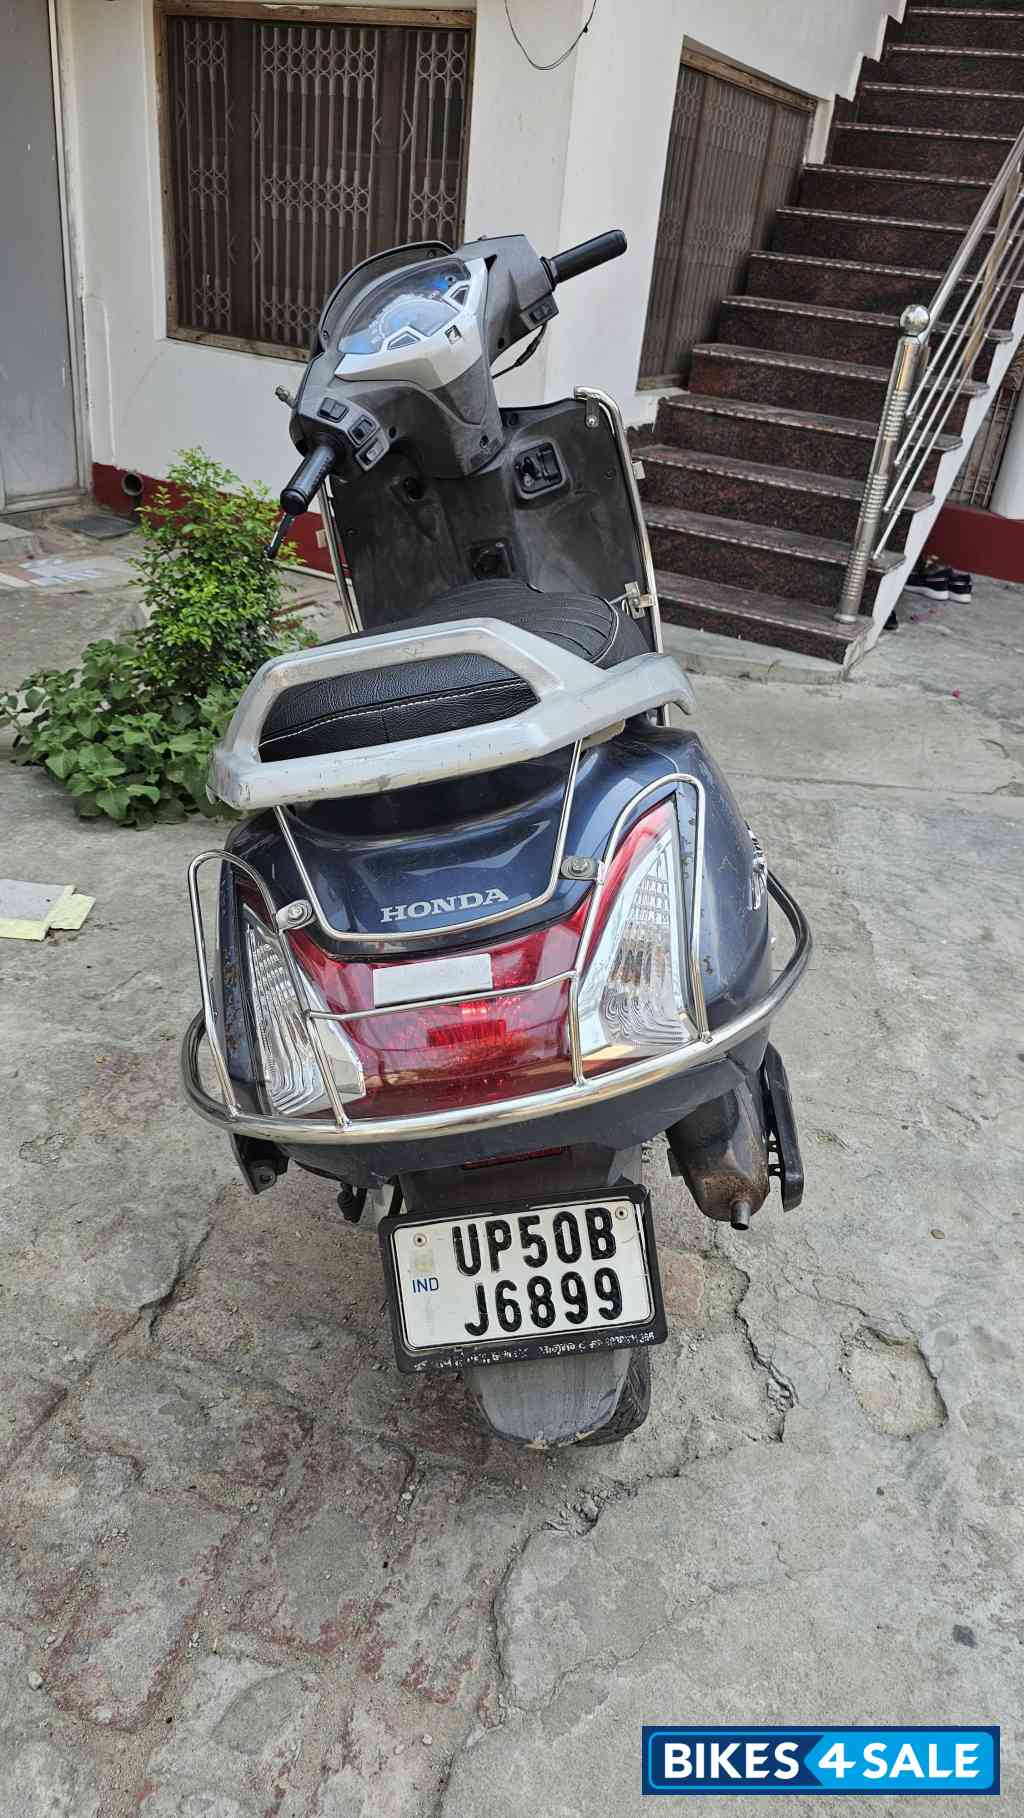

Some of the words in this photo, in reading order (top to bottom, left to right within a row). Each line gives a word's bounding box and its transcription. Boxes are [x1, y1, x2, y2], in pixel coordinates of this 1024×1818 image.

[380, 888, 509, 922] HONDA
[452, 1207, 616, 1276] UP50B
[412, 1277, 439, 1293] IND
[464, 1267, 623, 1336] J6899
